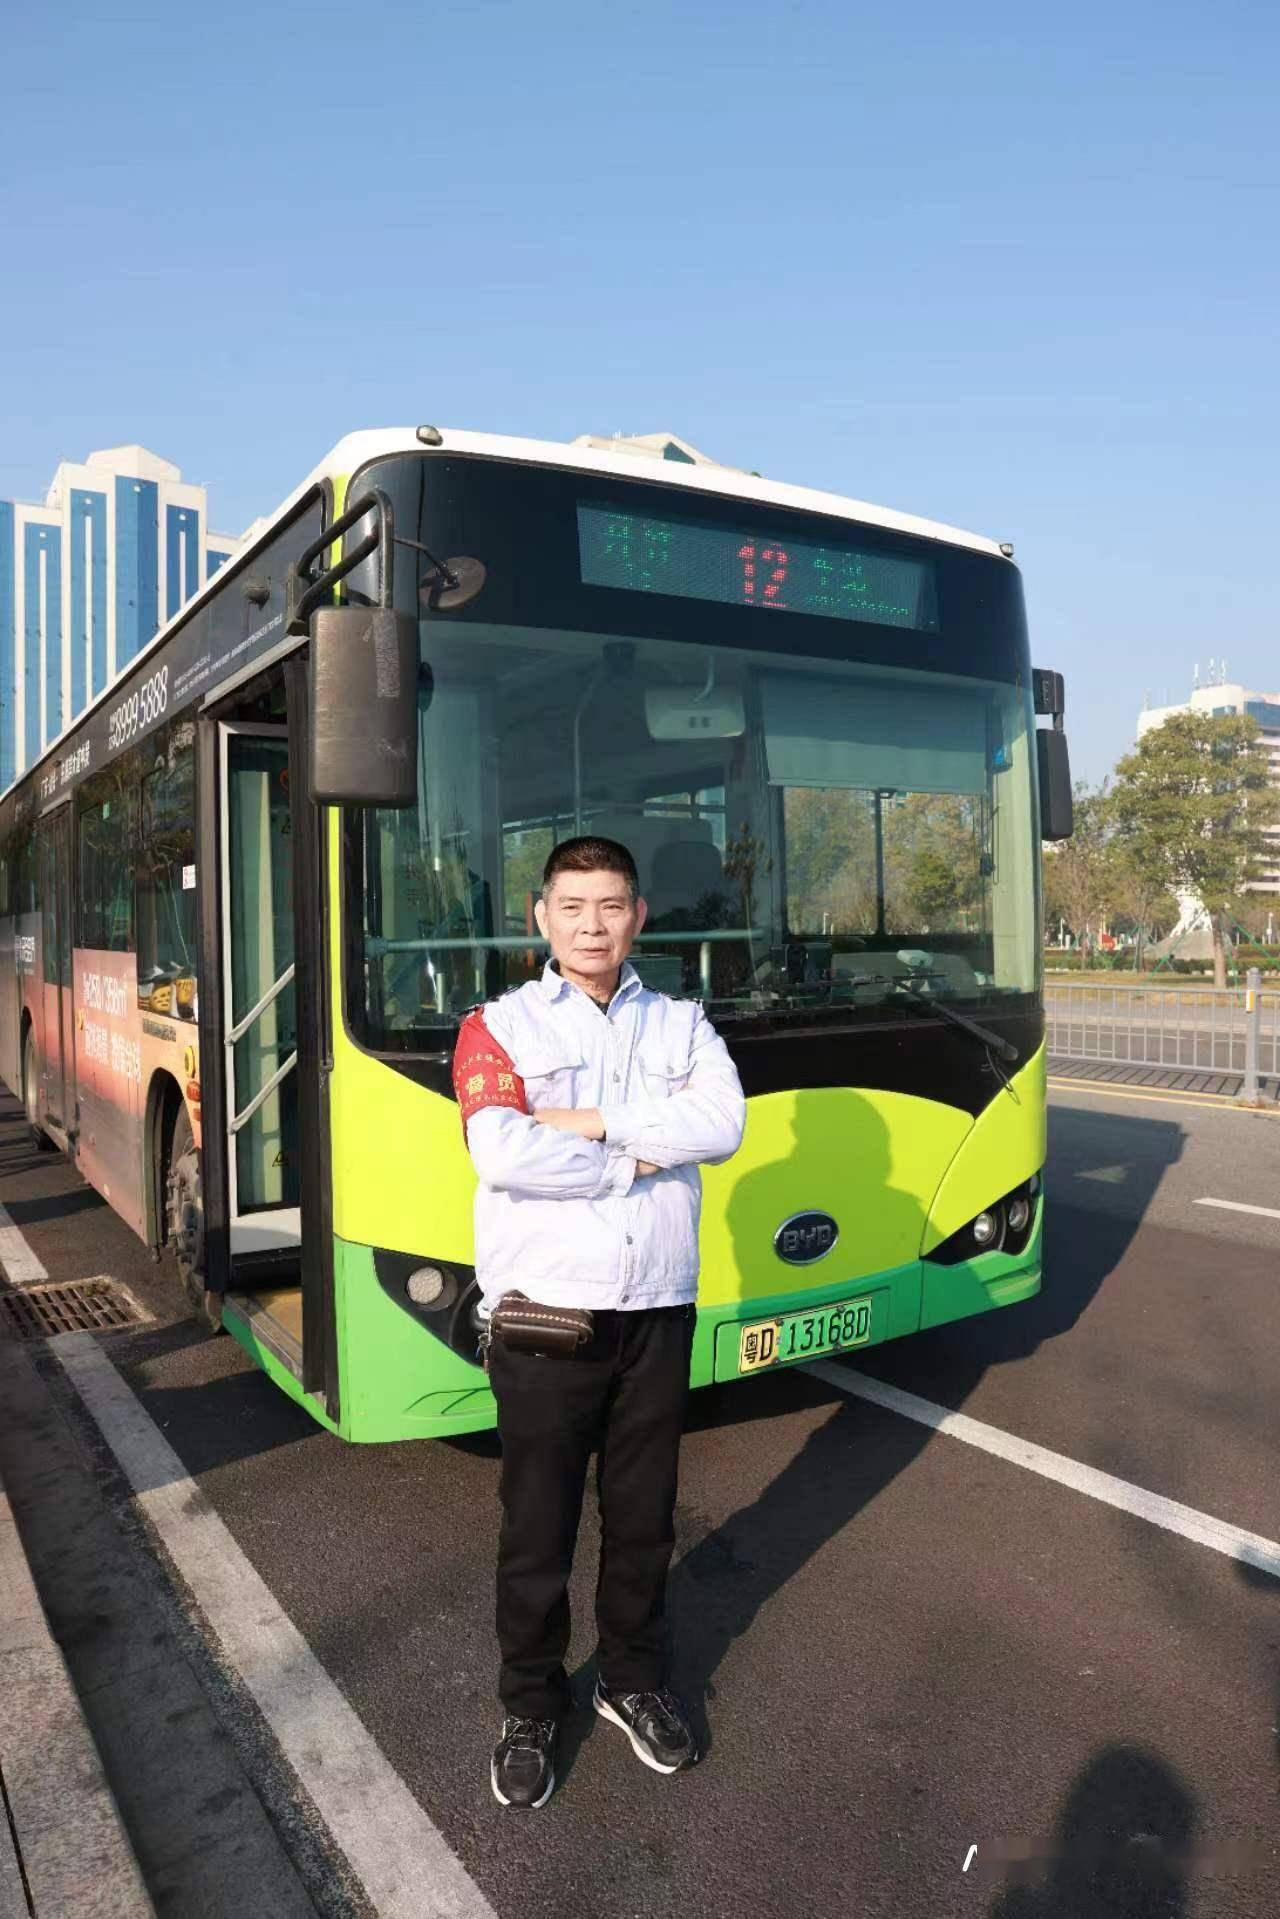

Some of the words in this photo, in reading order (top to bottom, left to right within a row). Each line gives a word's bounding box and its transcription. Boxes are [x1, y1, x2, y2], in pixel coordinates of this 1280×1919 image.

[738, 542, 787, 607] 12
[139, 664, 169, 727] 5888
[783, 1224, 832, 1252] BYD
